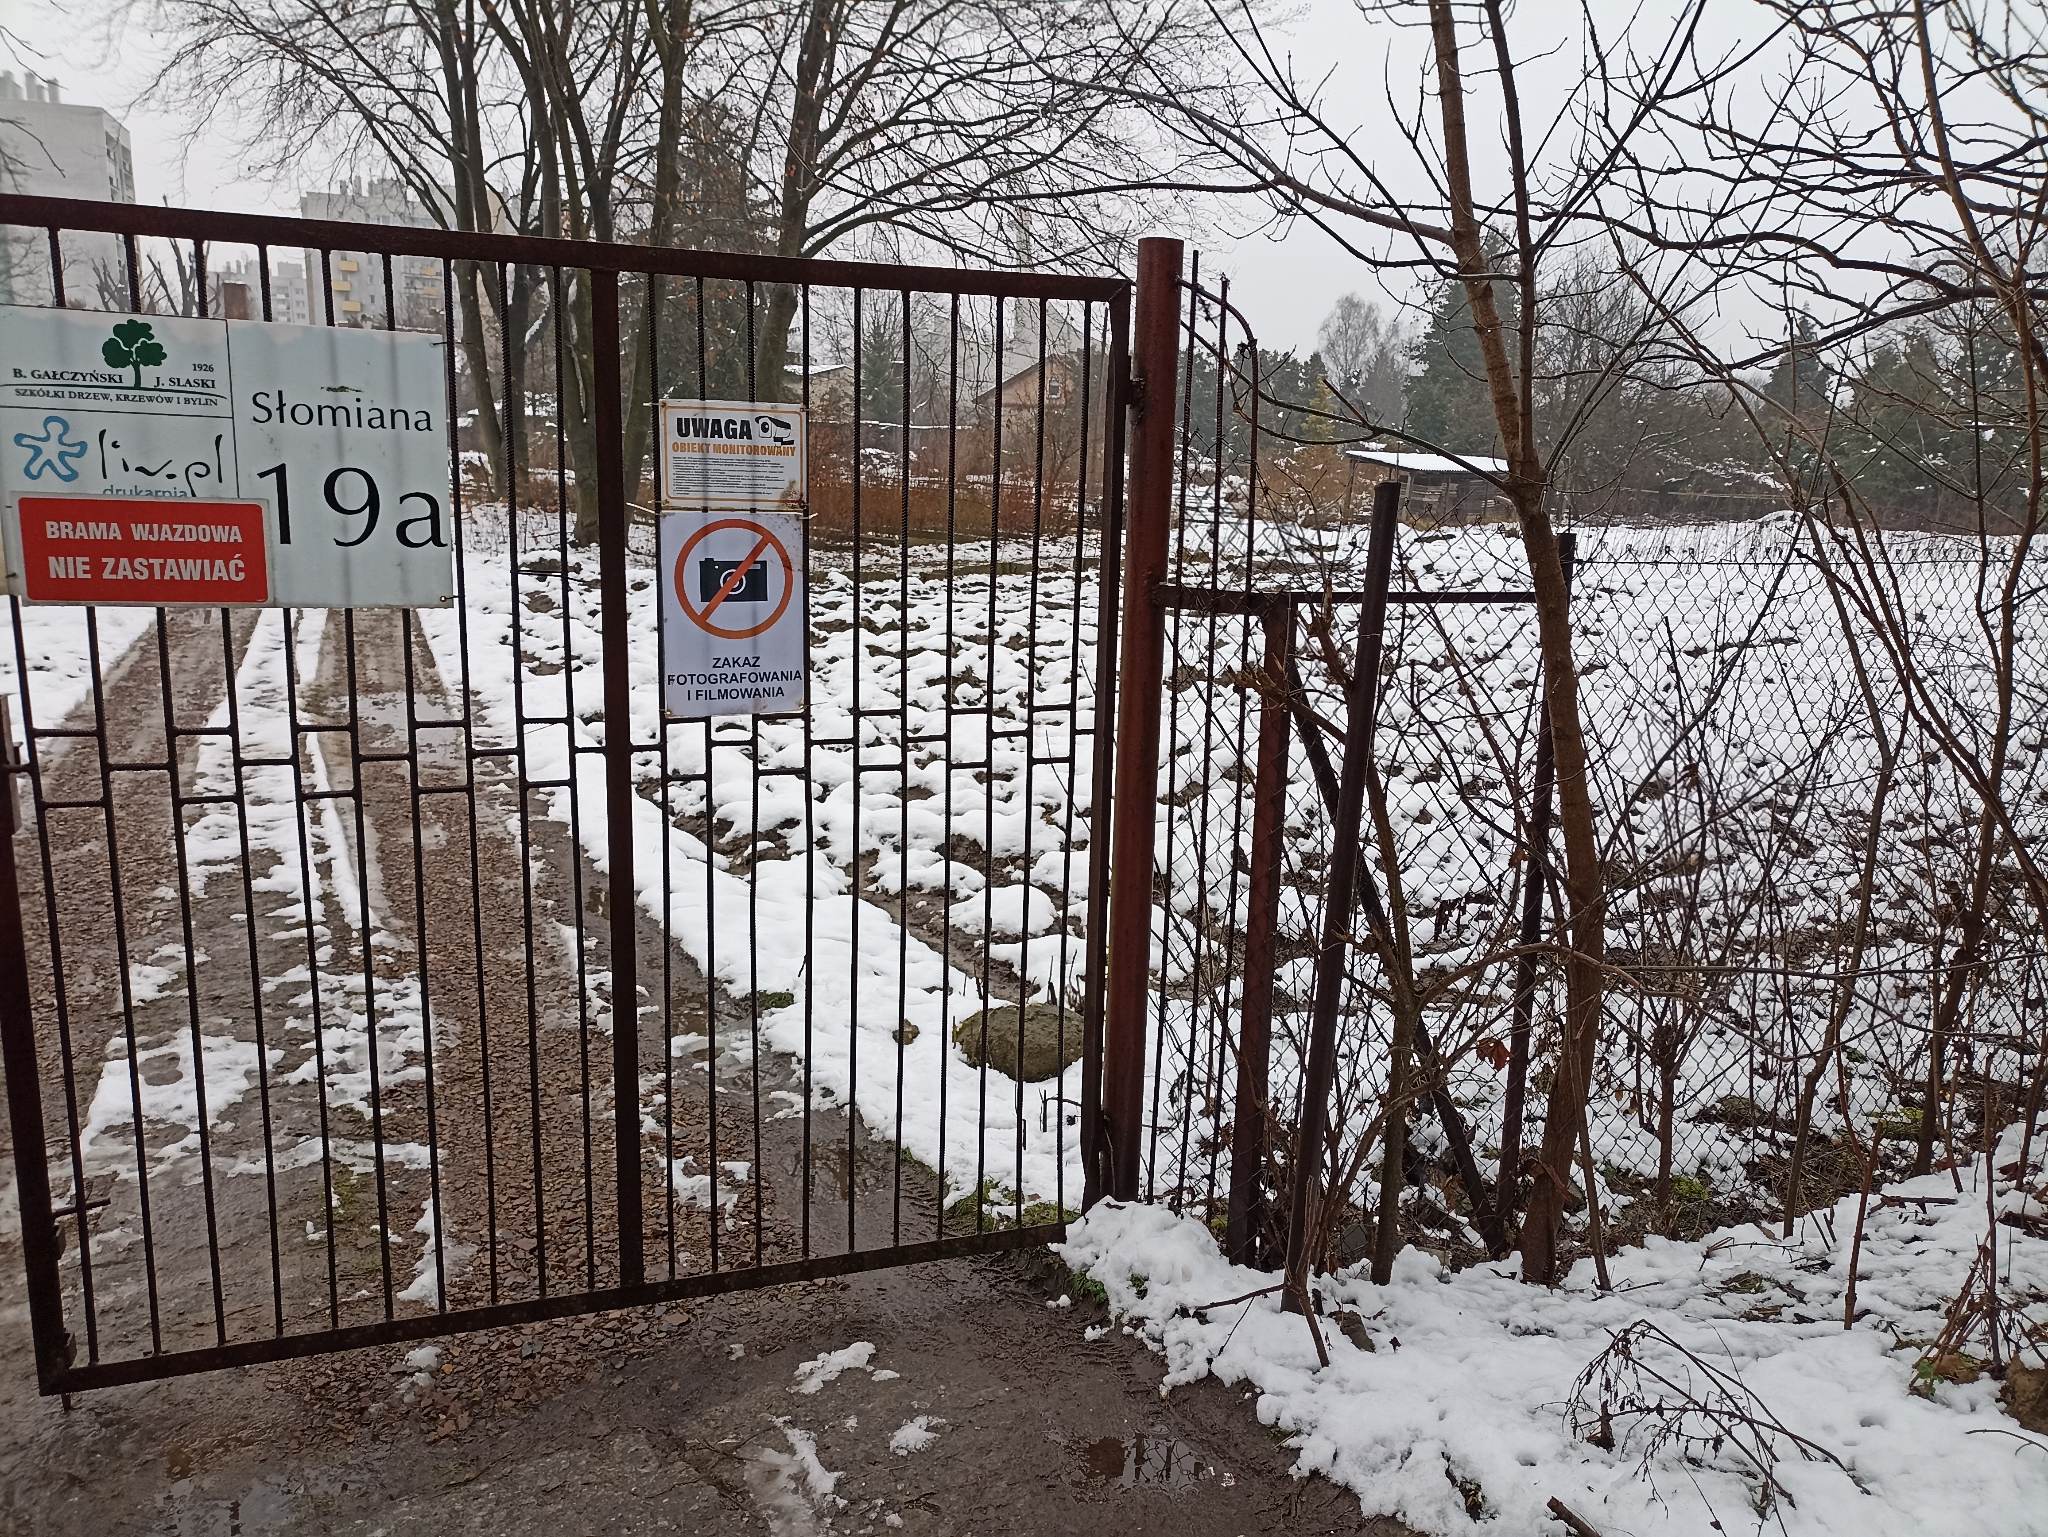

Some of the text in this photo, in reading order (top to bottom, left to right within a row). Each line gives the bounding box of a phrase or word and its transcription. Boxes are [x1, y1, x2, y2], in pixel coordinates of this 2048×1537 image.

[192, 363, 214, 373] 1926
[12, 368, 27, 379] B.
[31, 368, 124, 384] GAŁCZYŃSKI
[153, 376, 165, 388] J.
[15, 387, 218, 406] SZKÓŁKI DRZEW, KRZEWÓW I BYLIN
[252, 390, 432, 431] Słomiana
[676, 417, 753, 440] UWAGA
[672, 443, 796, 456] OBIEKT MONITOROWANY
[257, 463, 448, 548] 19a
[46, 521, 242, 542] BRAMA WJAZDOWA
[48, 554, 245, 582] NIE ZASTAWIAĆ
[712, 656, 761, 668] ZAKAZ
[667, 670, 802, 686] FOTOGRAFOWANIA
[687, 687, 785, 700] I FILMOWANIA
